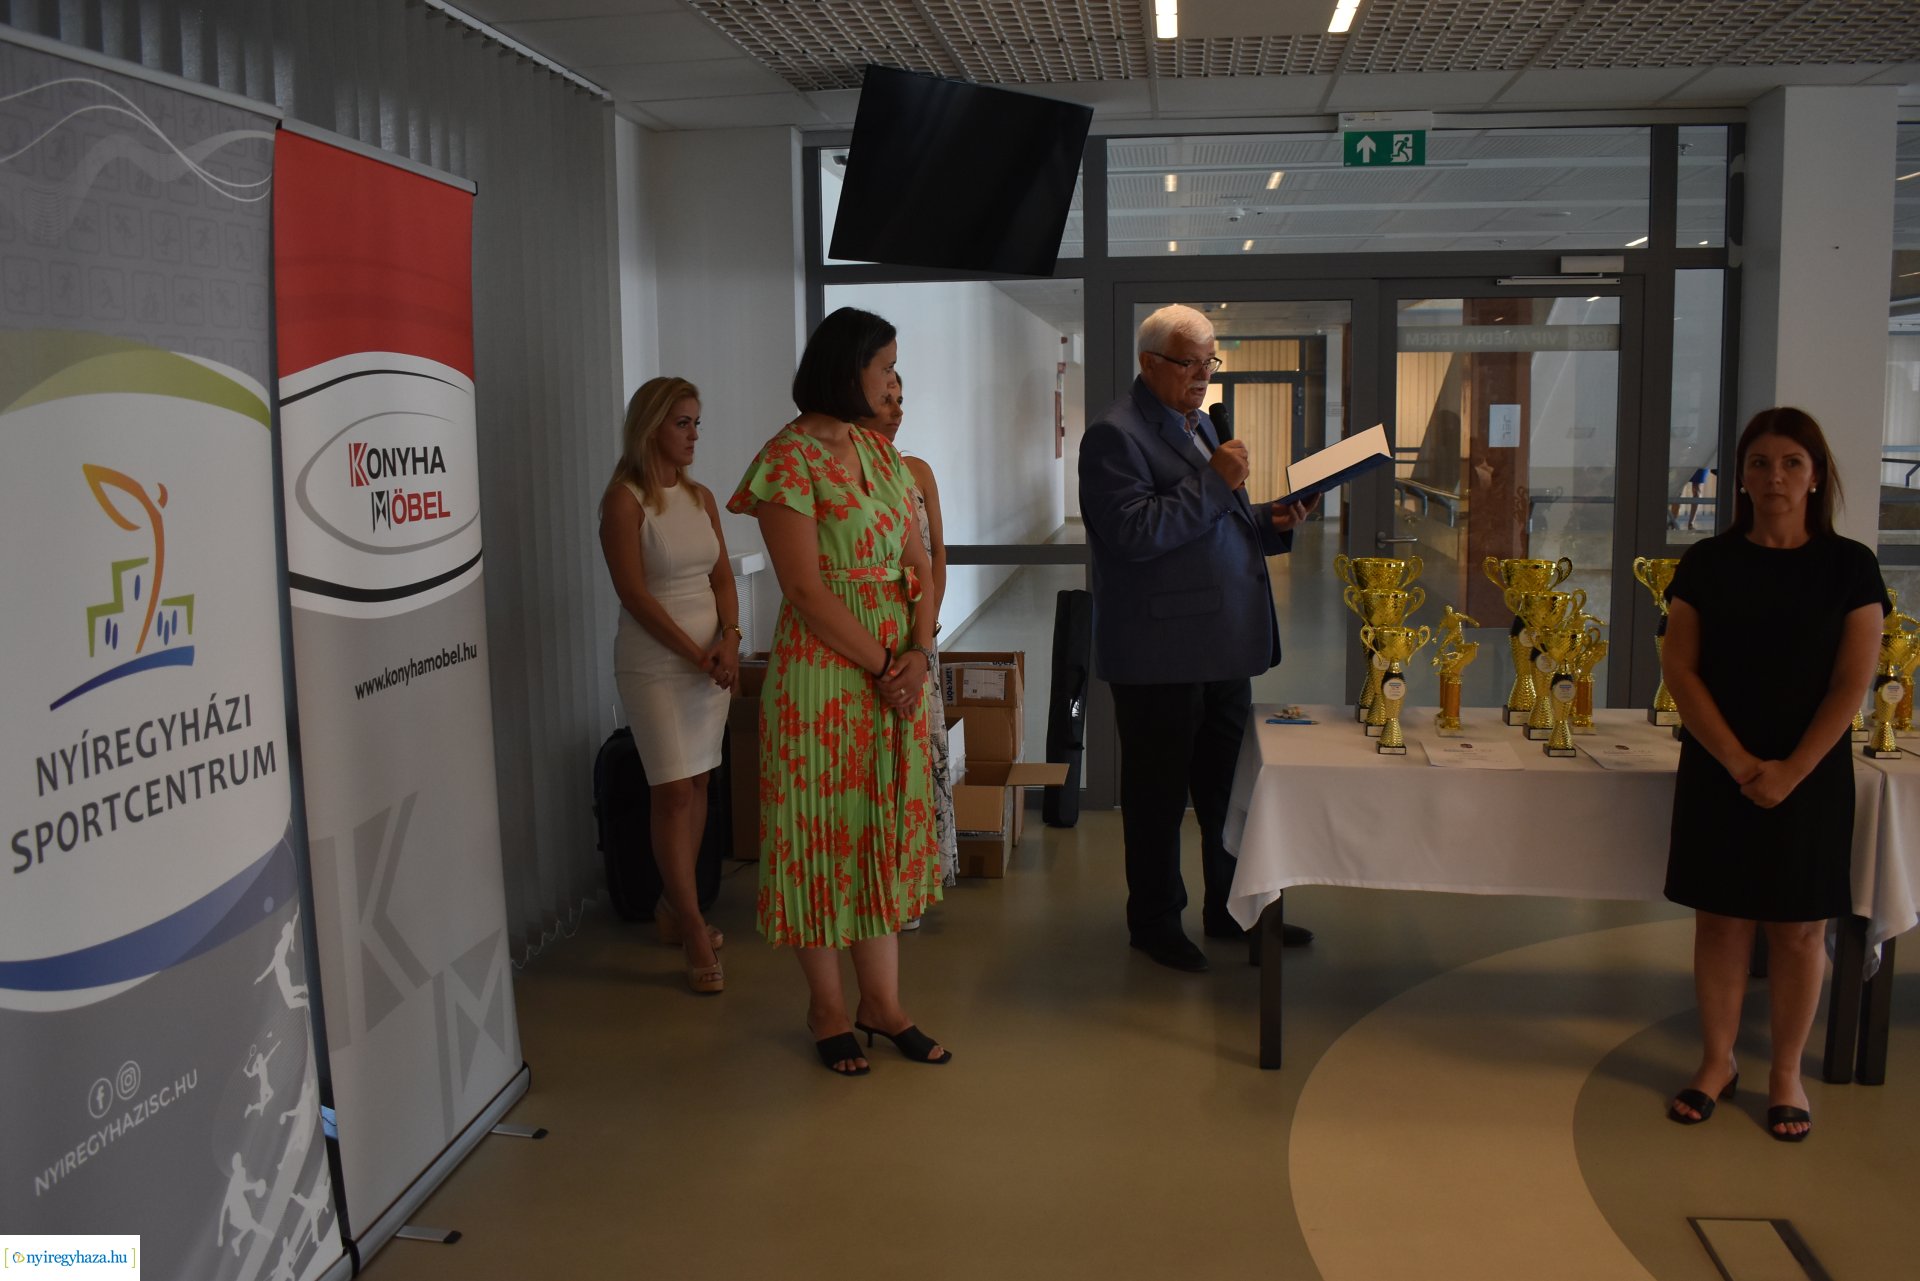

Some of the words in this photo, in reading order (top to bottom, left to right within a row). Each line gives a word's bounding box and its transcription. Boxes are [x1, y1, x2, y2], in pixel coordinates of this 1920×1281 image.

[349, 443, 446, 487] KONYHA
[371, 488, 451, 534] MÖBEL
[355, 642, 477, 700] www.konyhamobel.hu
[36, 693, 252, 797] NYÍREGYHÁZI
[11, 741, 277, 874] SPORTCENTRUM
[34, 1069, 198, 1197] NYIREGYHAZISC.HU
